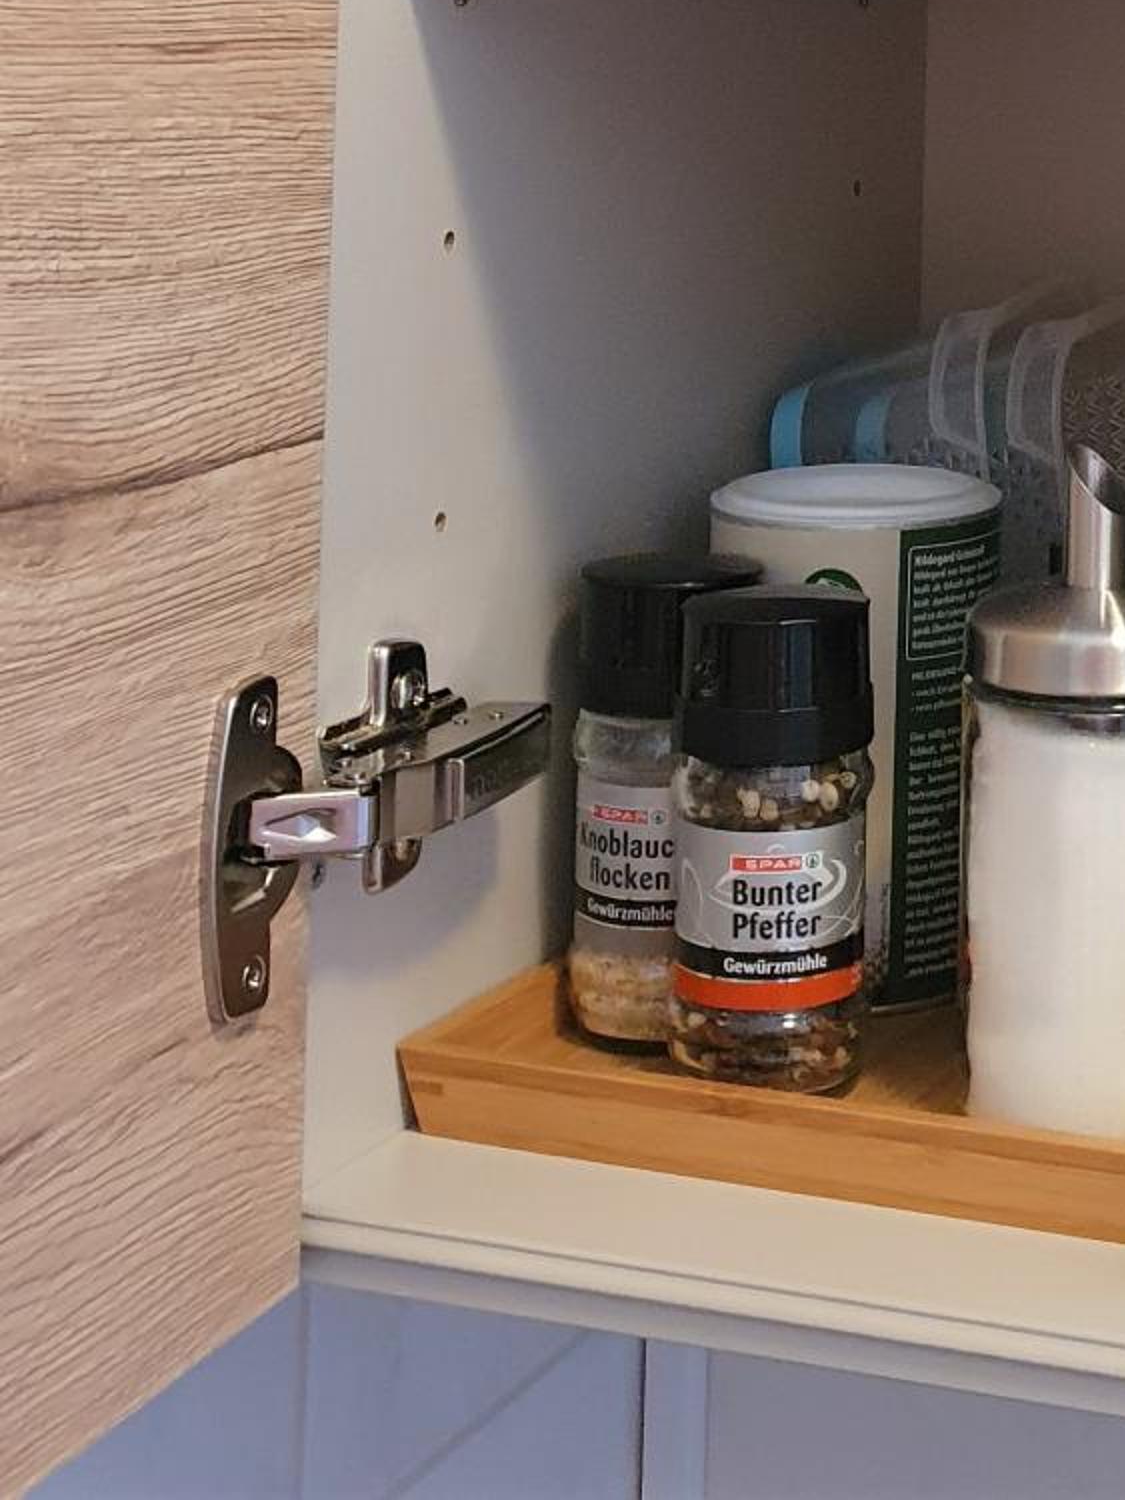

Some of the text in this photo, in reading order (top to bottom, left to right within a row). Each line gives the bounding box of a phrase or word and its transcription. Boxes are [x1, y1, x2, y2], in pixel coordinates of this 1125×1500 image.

[579, 821, 675, 859] Knoblauc
[745, 858, 802, 870] SPAR
[732, 878, 823, 907] Bunter
[732, 910, 822, 940] Pfeffer
[722, 952, 828, 976] Gewürzmühle
